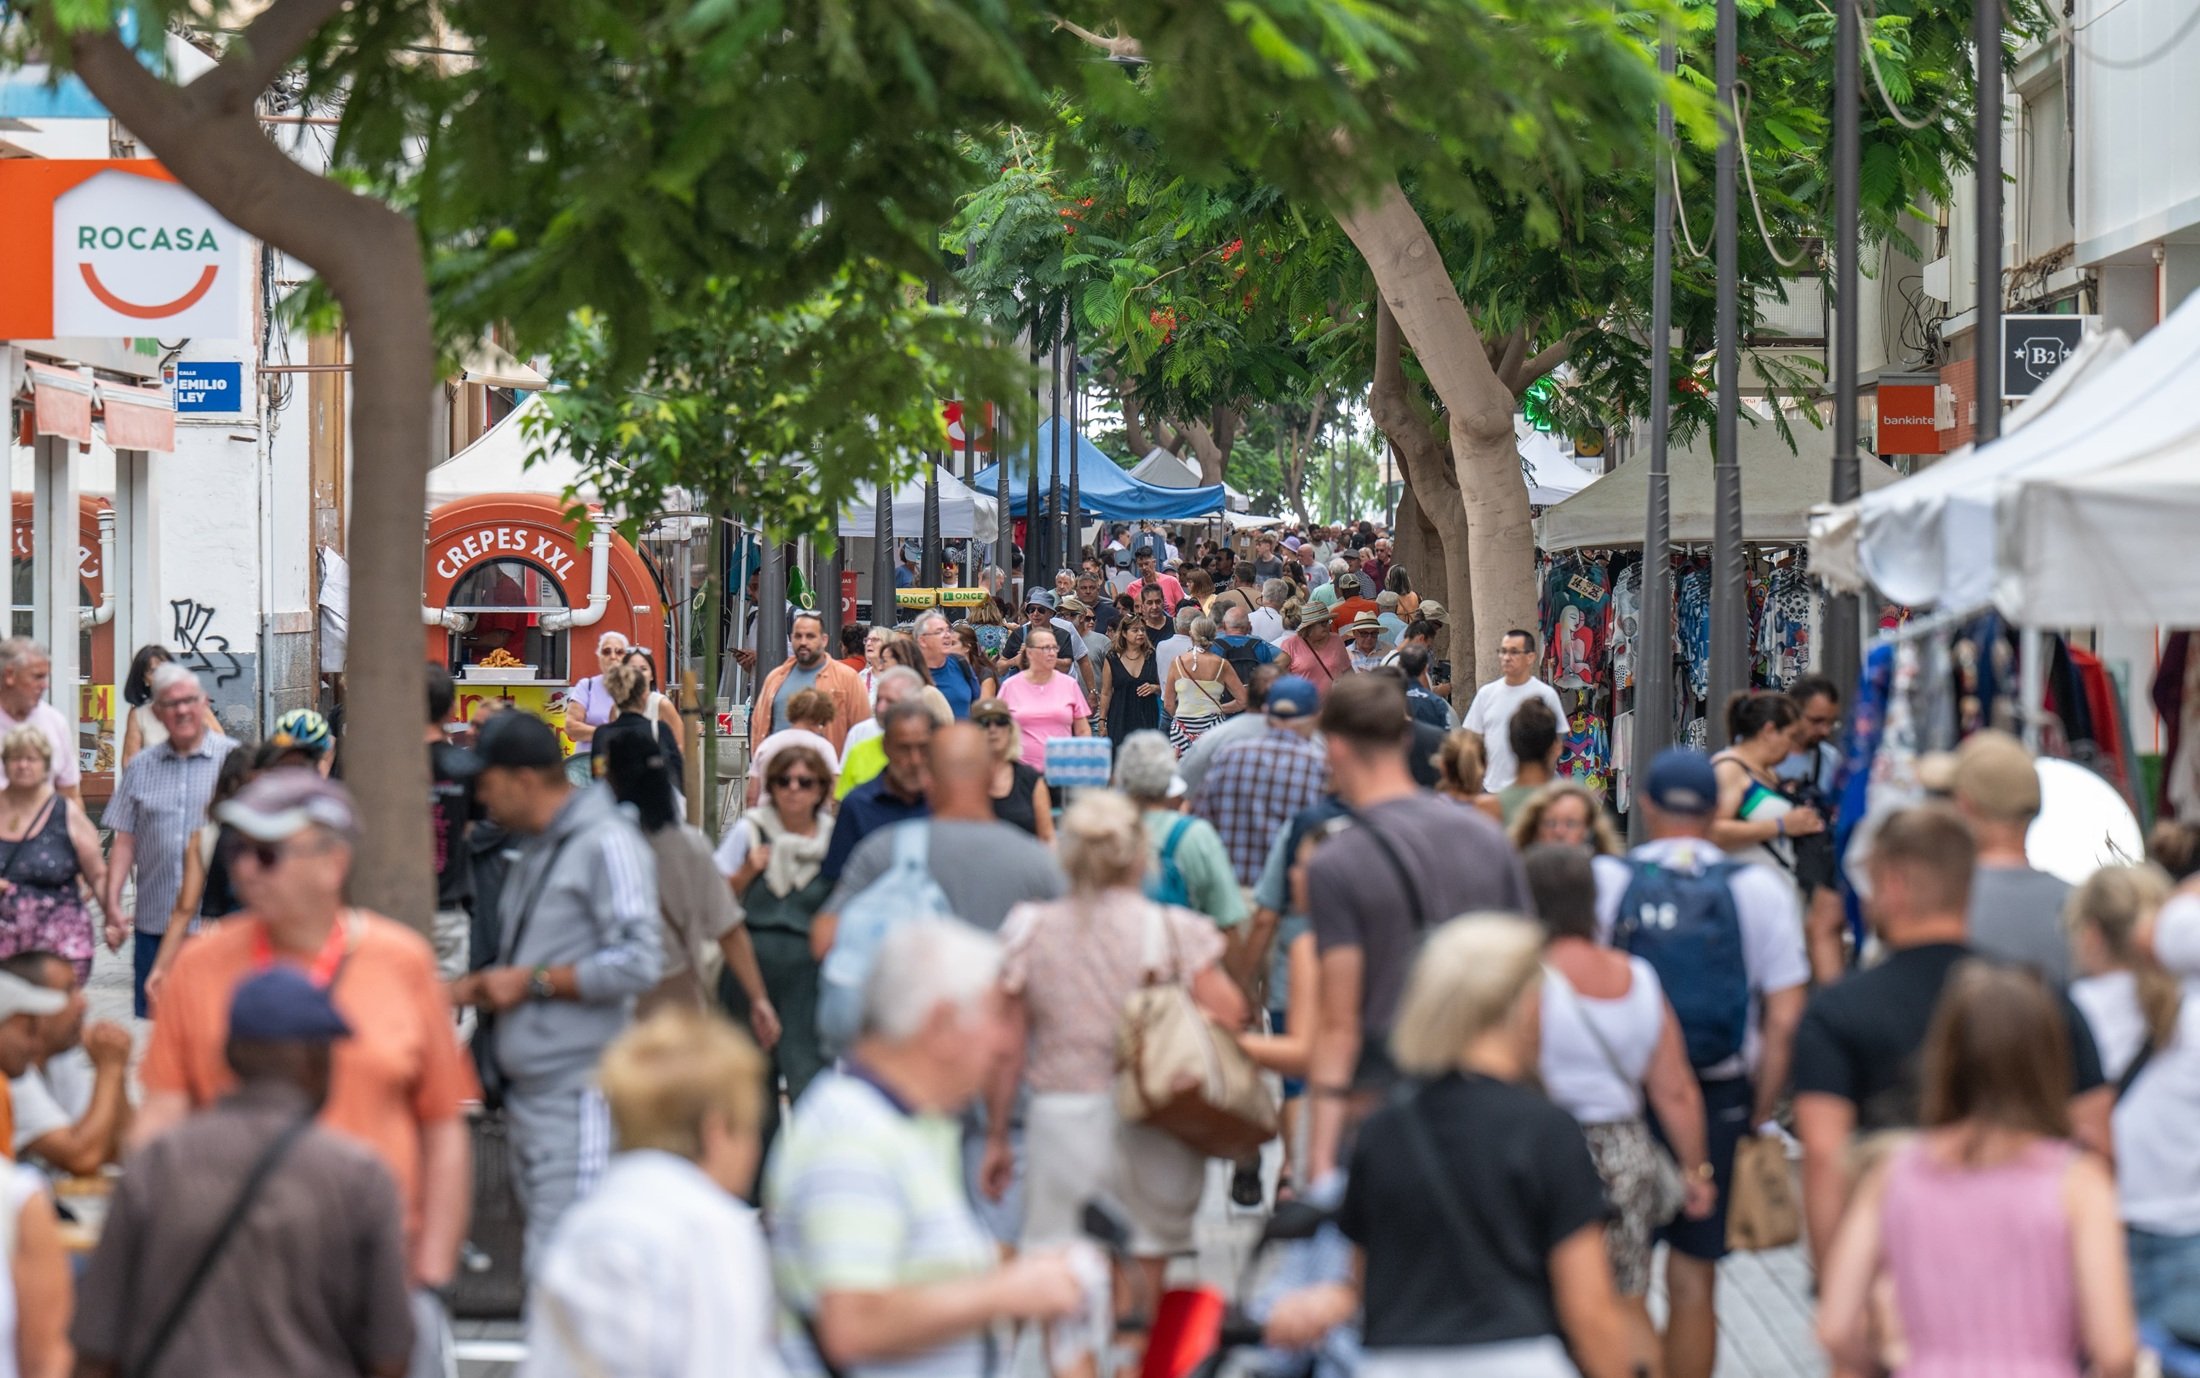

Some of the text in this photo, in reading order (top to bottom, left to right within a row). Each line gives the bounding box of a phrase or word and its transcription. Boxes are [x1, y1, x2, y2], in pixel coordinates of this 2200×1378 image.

[78, 226, 219, 251] ROCASA
[2031, 347, 2056, 364] B2
[178, 379, 228, 390] EMILIO
[178, 392, 206, 403] LEY
[1883, 415, 1936, 425] bankinte
[436, 528, 575, 581] CREPES XXL
[902, 596, 930, 605] ONCE
[954, 592, 983, 600] ONCE
